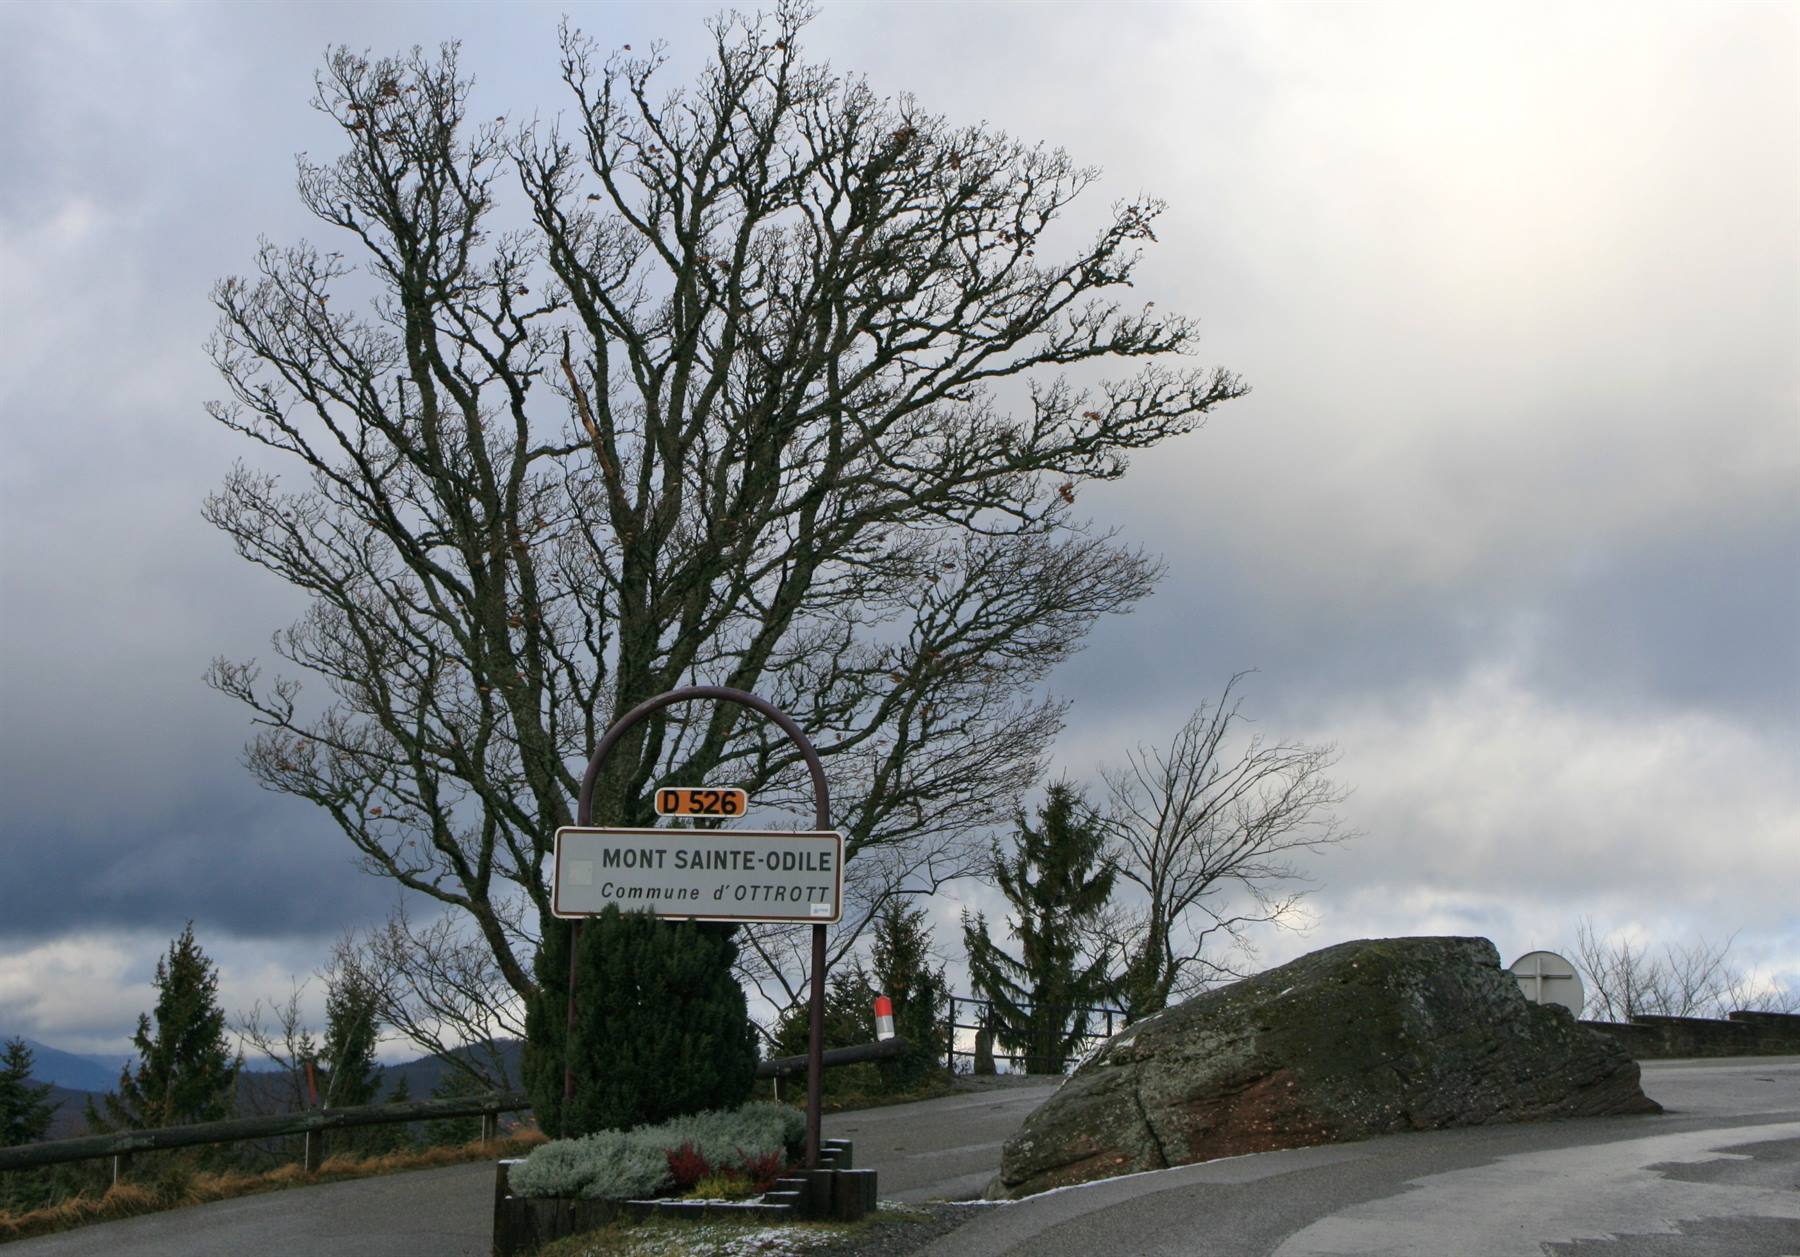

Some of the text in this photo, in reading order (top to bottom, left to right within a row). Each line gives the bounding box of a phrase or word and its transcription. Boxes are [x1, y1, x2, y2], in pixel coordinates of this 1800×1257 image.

[663, 790, 738, 815] D 526
[602, 848, 832, 872] MONT SAINTE-ODILE
[601, 882, 830, 903] Commune d'OTTROTT
